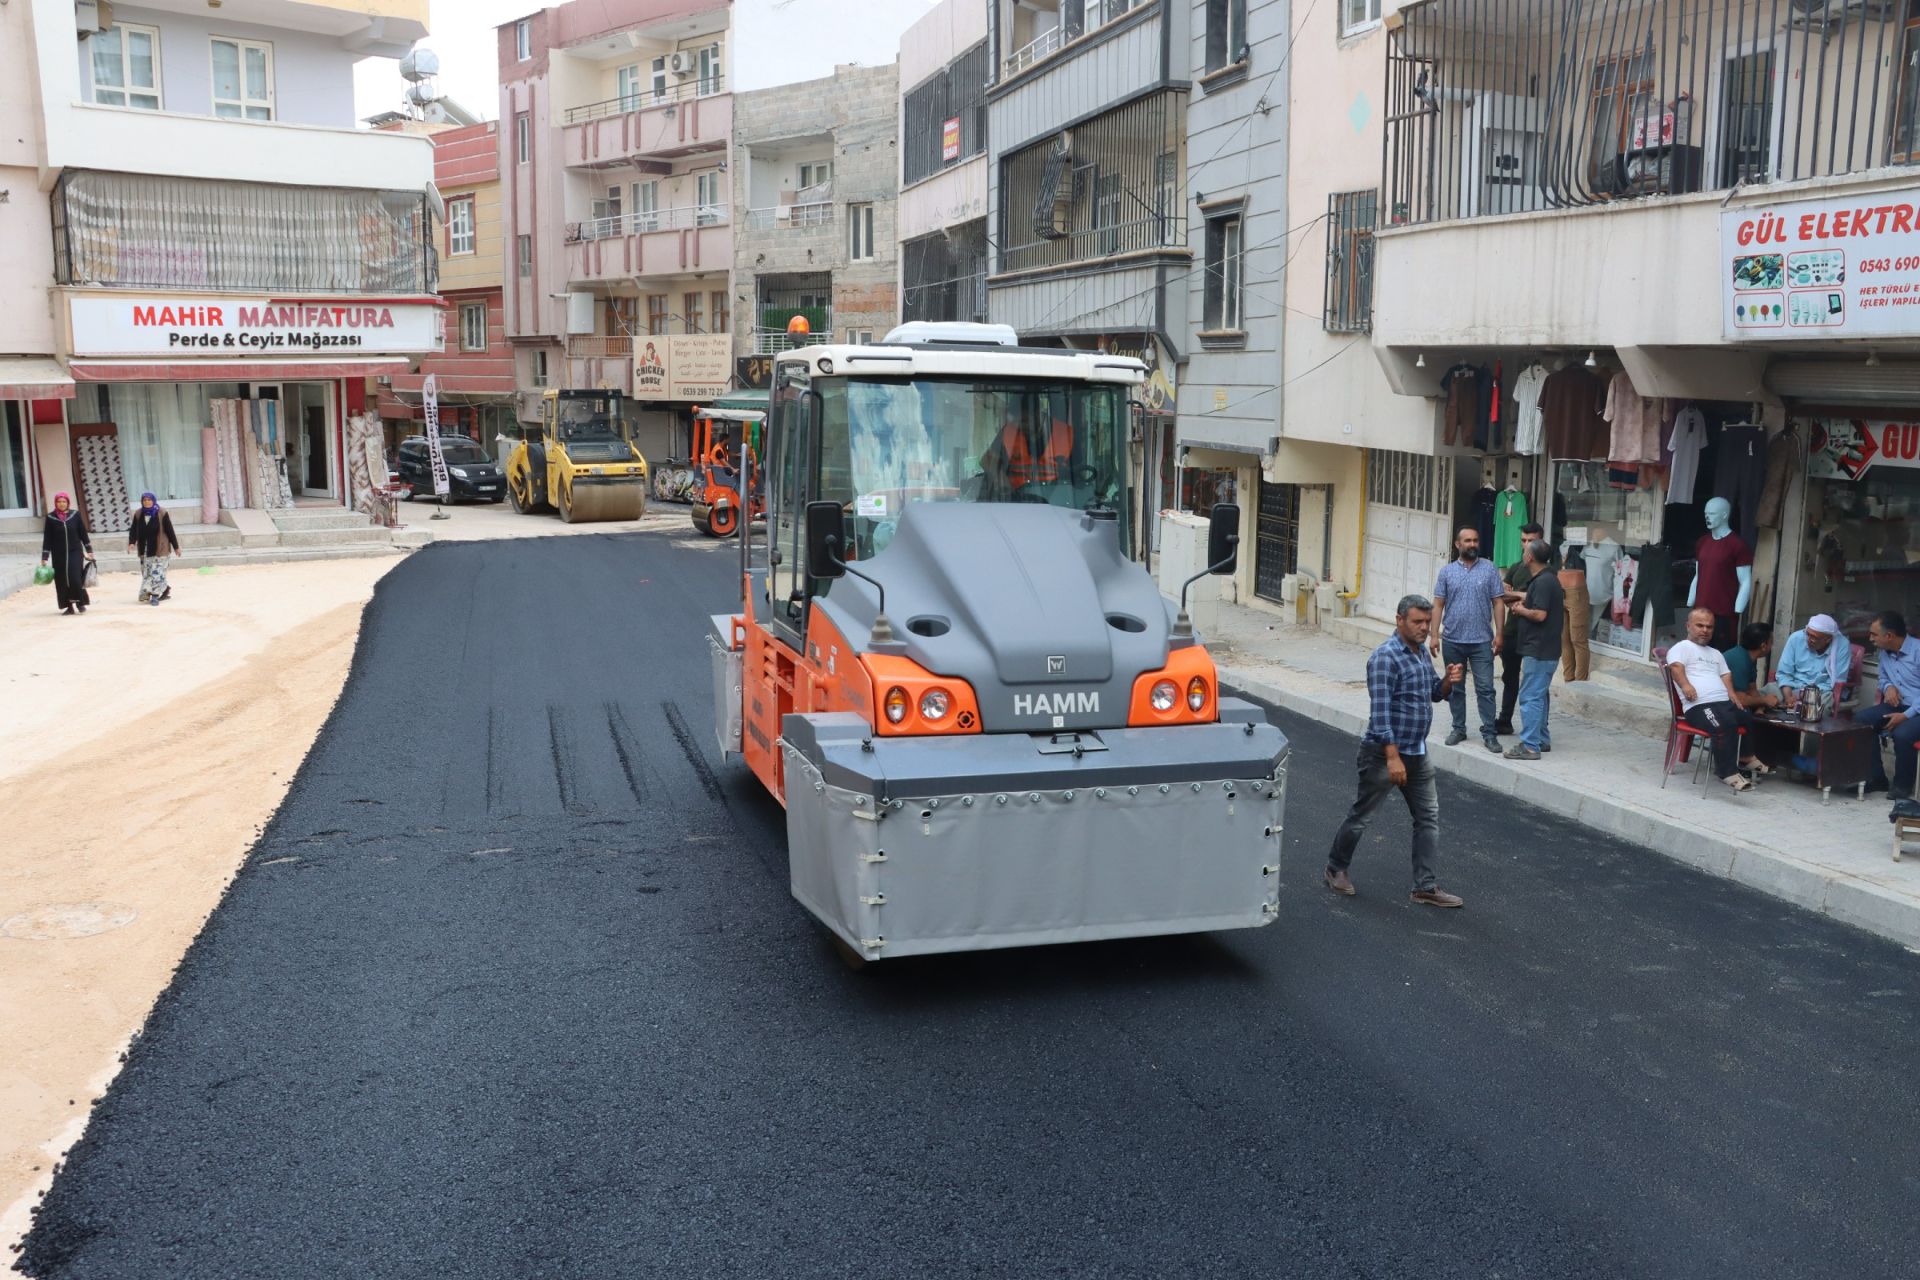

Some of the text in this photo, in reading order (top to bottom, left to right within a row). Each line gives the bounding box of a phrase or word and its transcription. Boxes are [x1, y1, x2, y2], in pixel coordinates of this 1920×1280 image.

[1737, 212, 1787, 246] GÜL
[1859, 256, 1920, 273] 0543 690
[1860, 287, 1878, 295] HER
[238, 302, 395, 328] MANİFATURA
[169, 332, 362, 349] Perde & Ceyiz Mağazası
[636, 365, 665, 377] CHICKEN
[640, 376, 661, 385] HOUSE
[1014, 691, 1099, 715] HAMM
